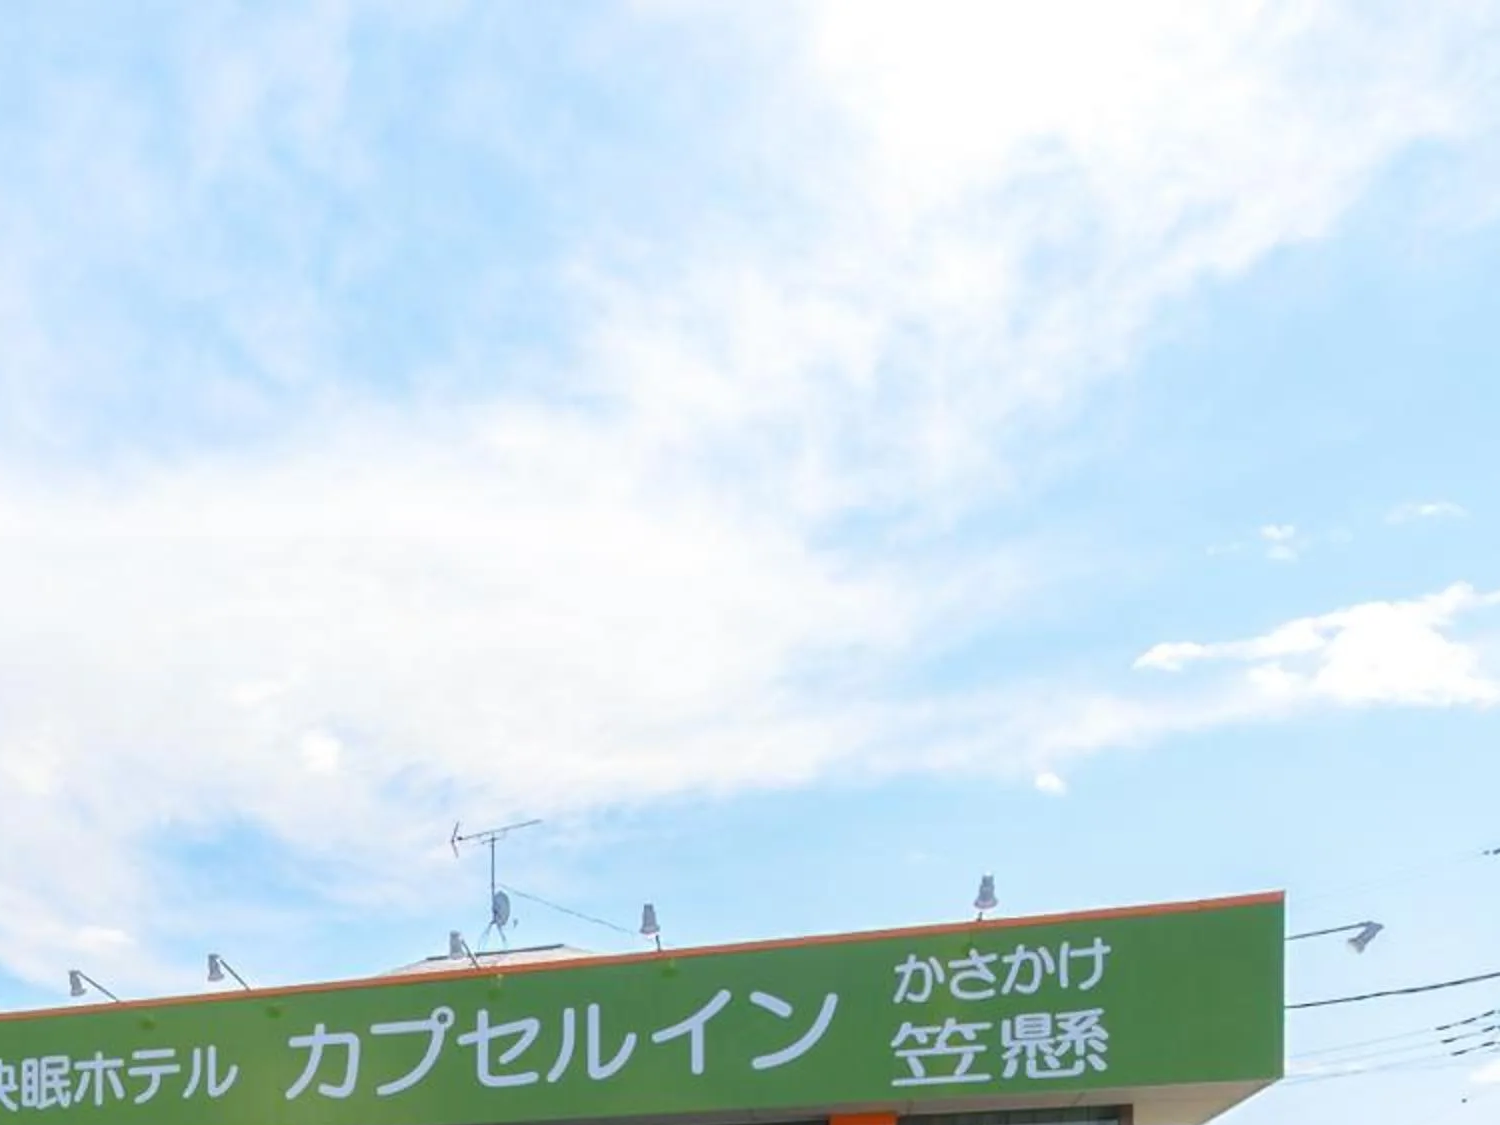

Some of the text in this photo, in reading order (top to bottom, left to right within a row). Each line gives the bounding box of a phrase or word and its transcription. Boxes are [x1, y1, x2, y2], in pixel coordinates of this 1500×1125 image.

[893, 937, 1112, 1004] かさかけ
[285, 989, 839, 1100] カプセルイン
[890, 1008, 1109, 1087] 笠懸
